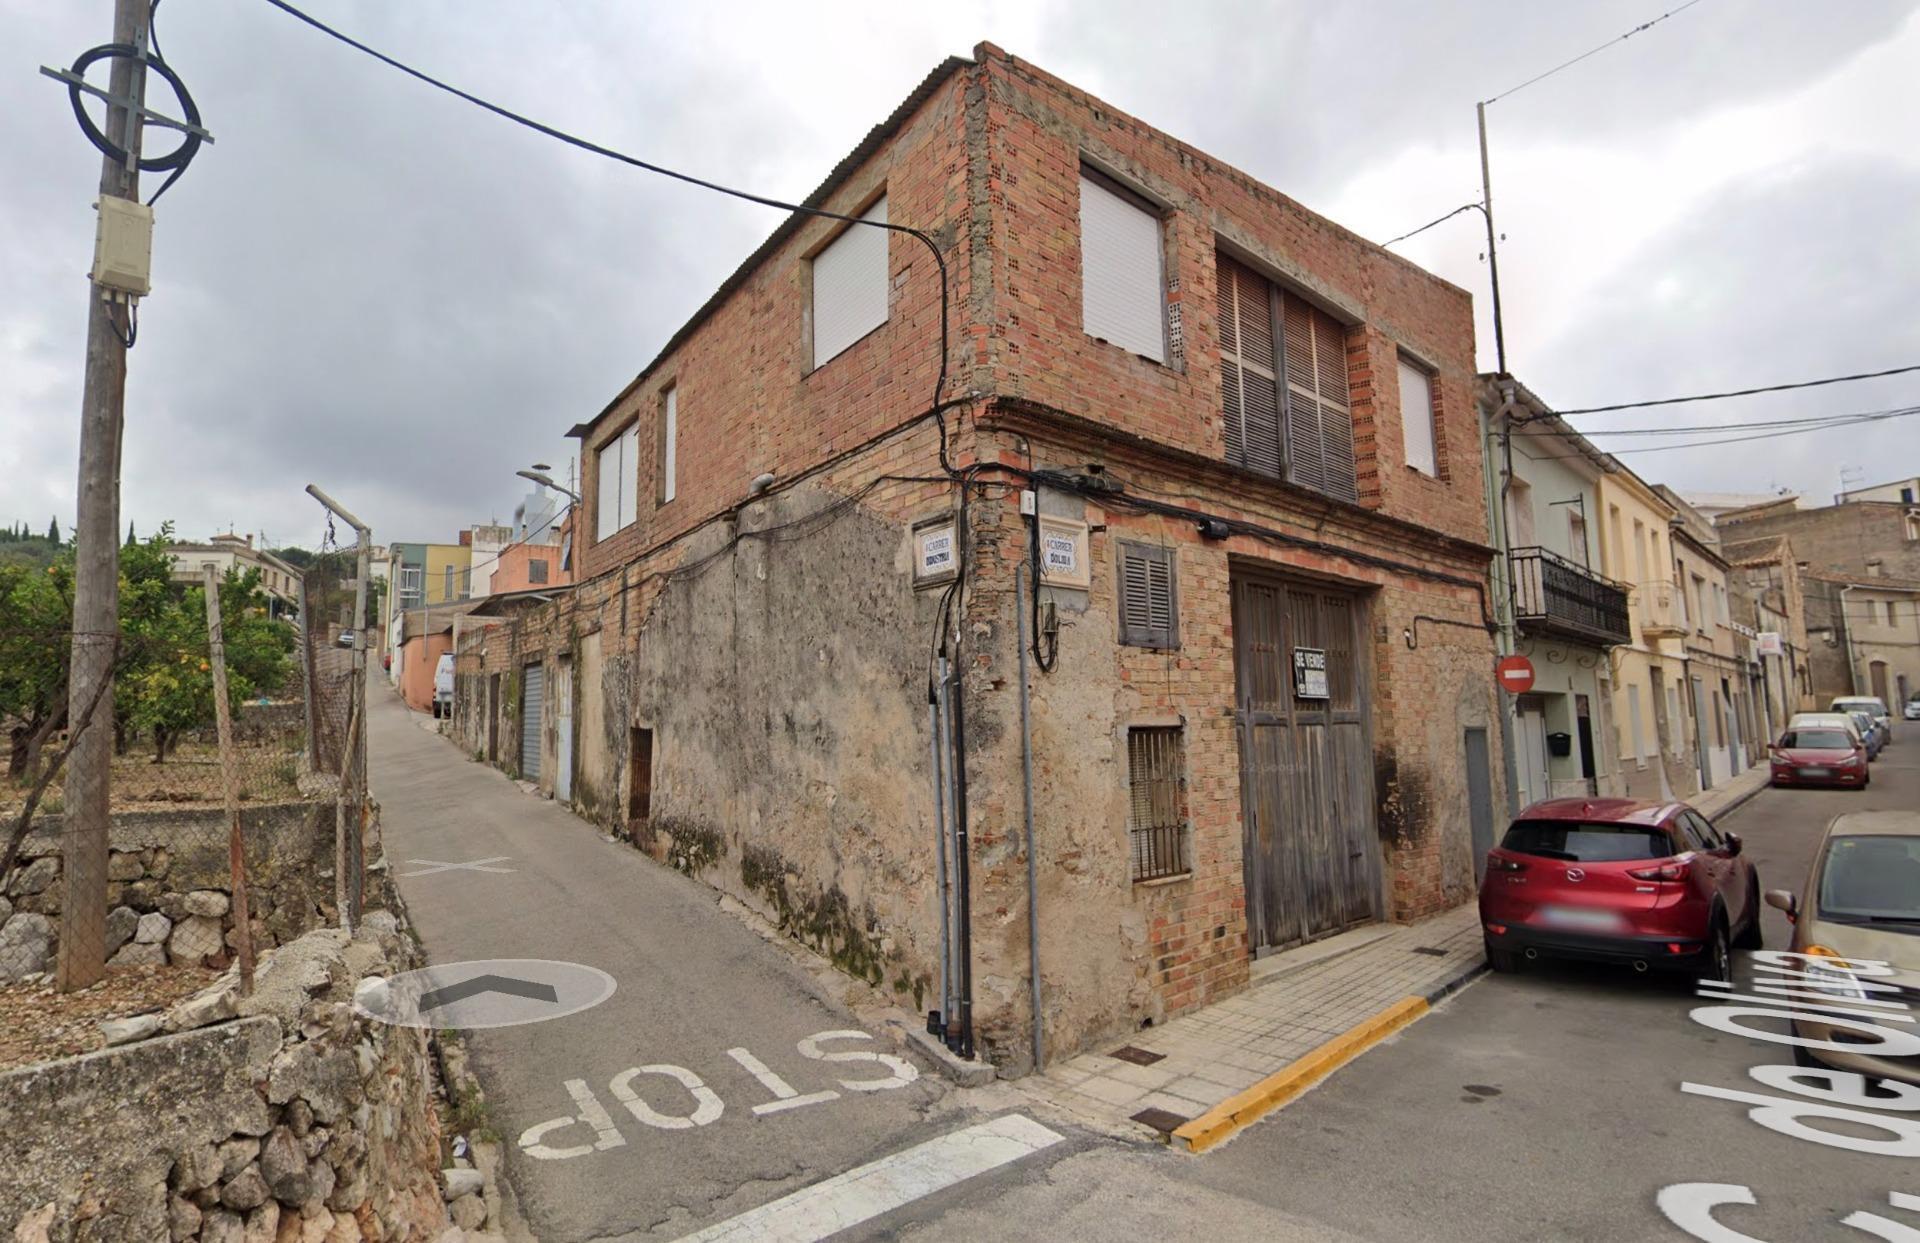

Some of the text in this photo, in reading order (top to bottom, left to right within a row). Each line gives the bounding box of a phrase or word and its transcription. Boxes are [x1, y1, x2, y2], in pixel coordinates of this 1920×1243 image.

[928, 537, 950, 552] CARRER
[1050, 539, 1073, 552] CARRER
[1296, 651, 1325, 669] SE VENDE
[517, 1030, 920, 1160] STOP
